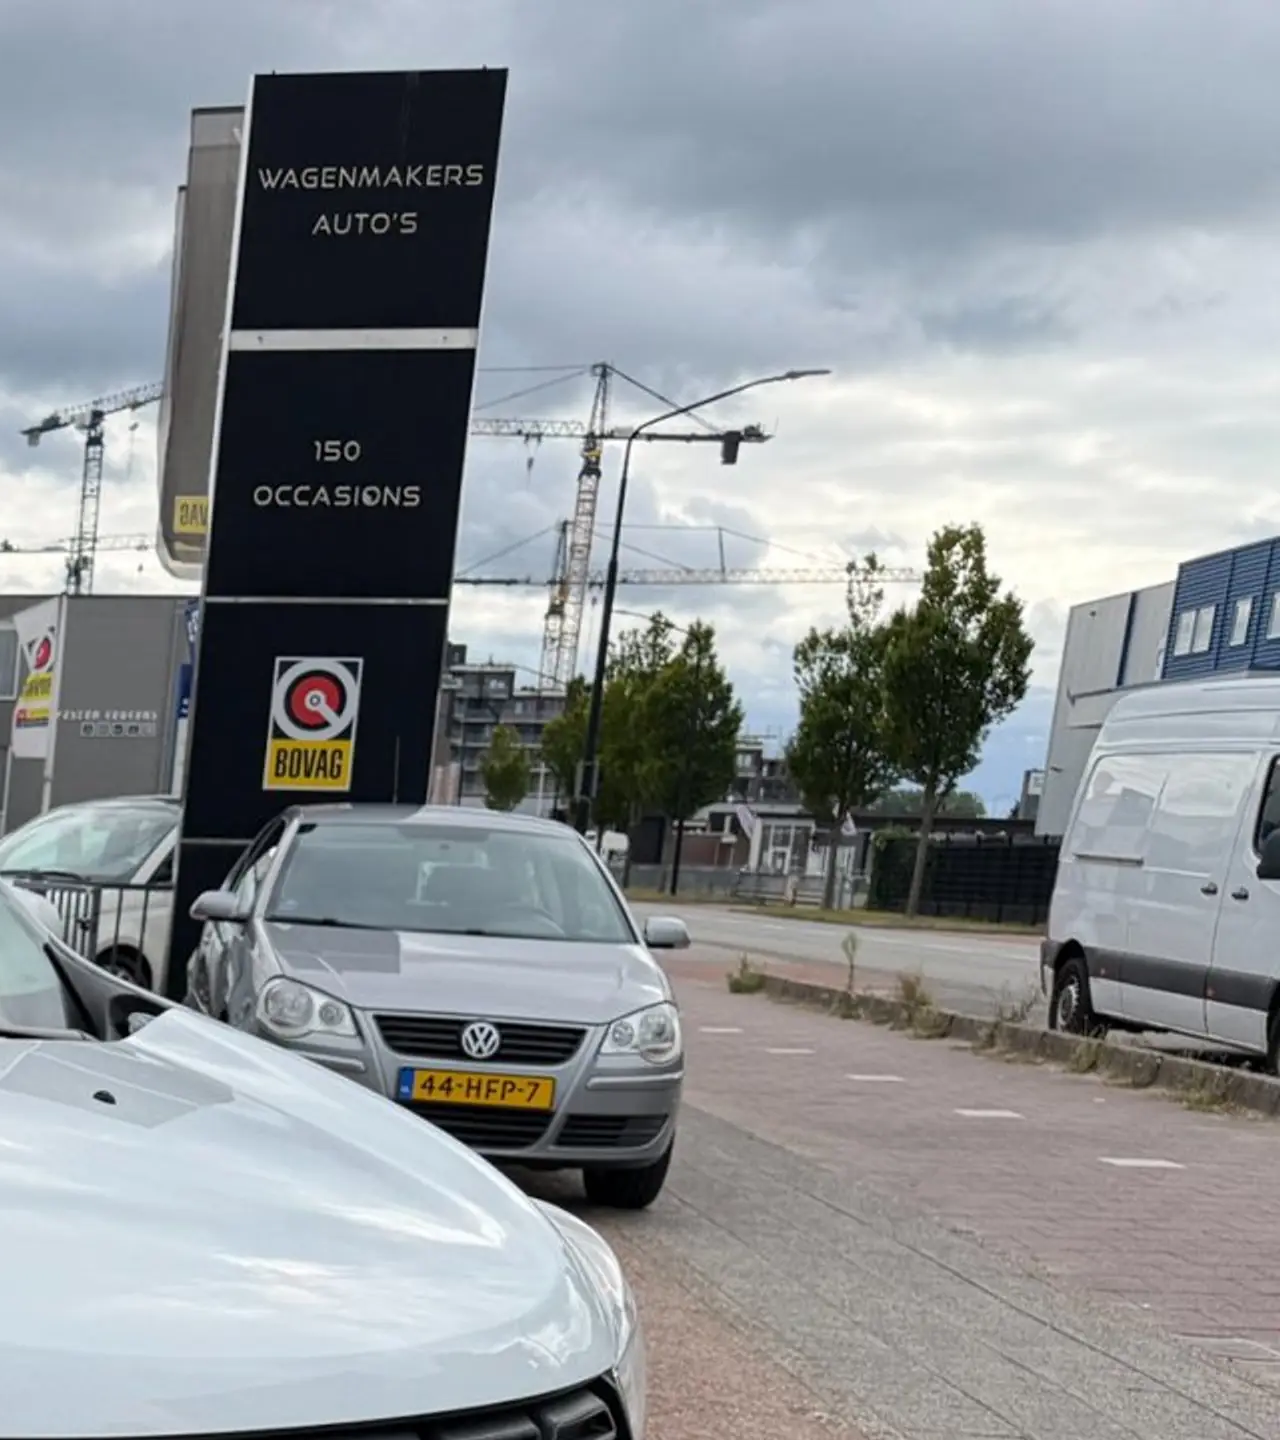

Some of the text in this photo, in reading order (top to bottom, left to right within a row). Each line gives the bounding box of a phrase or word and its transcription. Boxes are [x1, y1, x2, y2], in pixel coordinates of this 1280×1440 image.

[258, 164, 484, 190] WAGENMAKERS
[311, 212, 418, 236] AUTO'S
[313, 440, 361, 462] 150
[253, 485, 421, 508] OCCASIONS
[274, 747, 344, 779] BOVAG
[420, 1074, 541, 1103] 44-HFP-7
